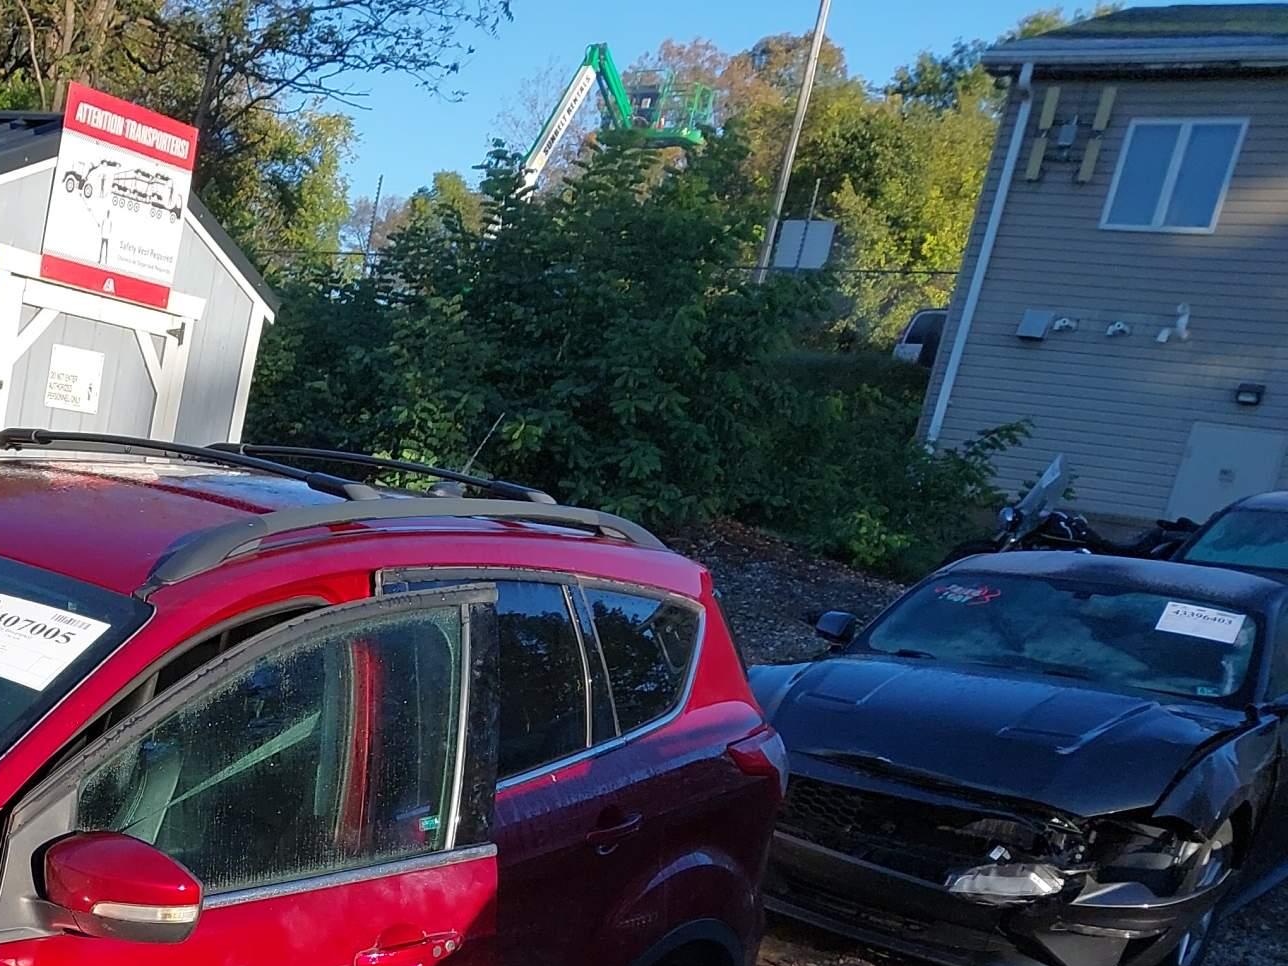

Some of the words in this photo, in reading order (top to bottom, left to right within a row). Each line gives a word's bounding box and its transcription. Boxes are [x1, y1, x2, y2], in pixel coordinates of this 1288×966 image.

[75, 101, 125, 137] ATTENTION
[125, 118, 190, 160] TRANSPORTERS!
[543, 114, 567, 156] SUNBELT
[567, 75, 591, 116] RENTALS
